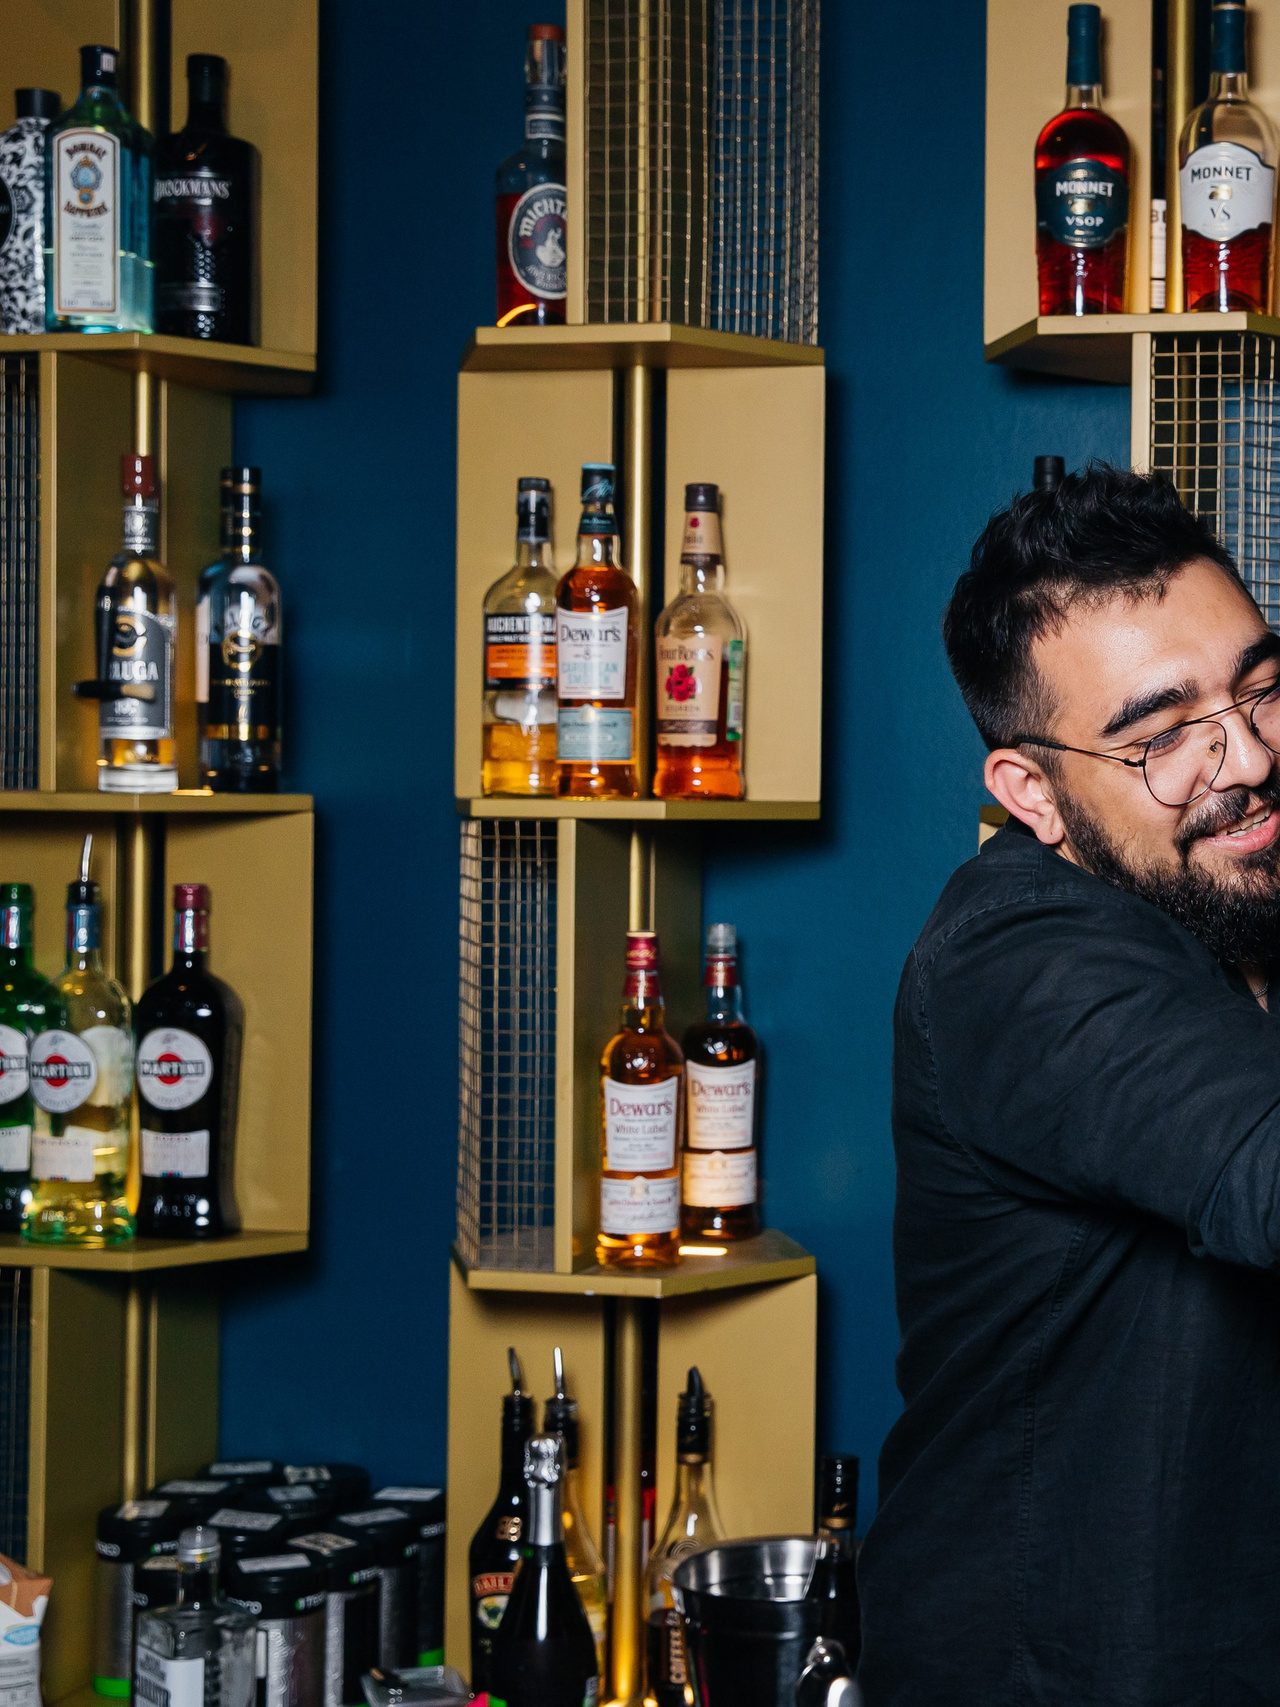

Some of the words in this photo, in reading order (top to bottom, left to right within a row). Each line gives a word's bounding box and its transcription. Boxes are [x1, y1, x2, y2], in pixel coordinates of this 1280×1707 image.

[1191, 166, 1253, 183] MONNET
[1056, 181, 1114, 198] MONNET
[1210, 202, 1231, 221] VS
[1065, 215, 1104, 227] VSOP
[32, 1061, 91, 1080] MARTINI
[141, 1060, 205, 1076] MARTINI
[691, 1079, 751, 1096] Dewar's
[609, 1096, 673, 1117] Dewar's
